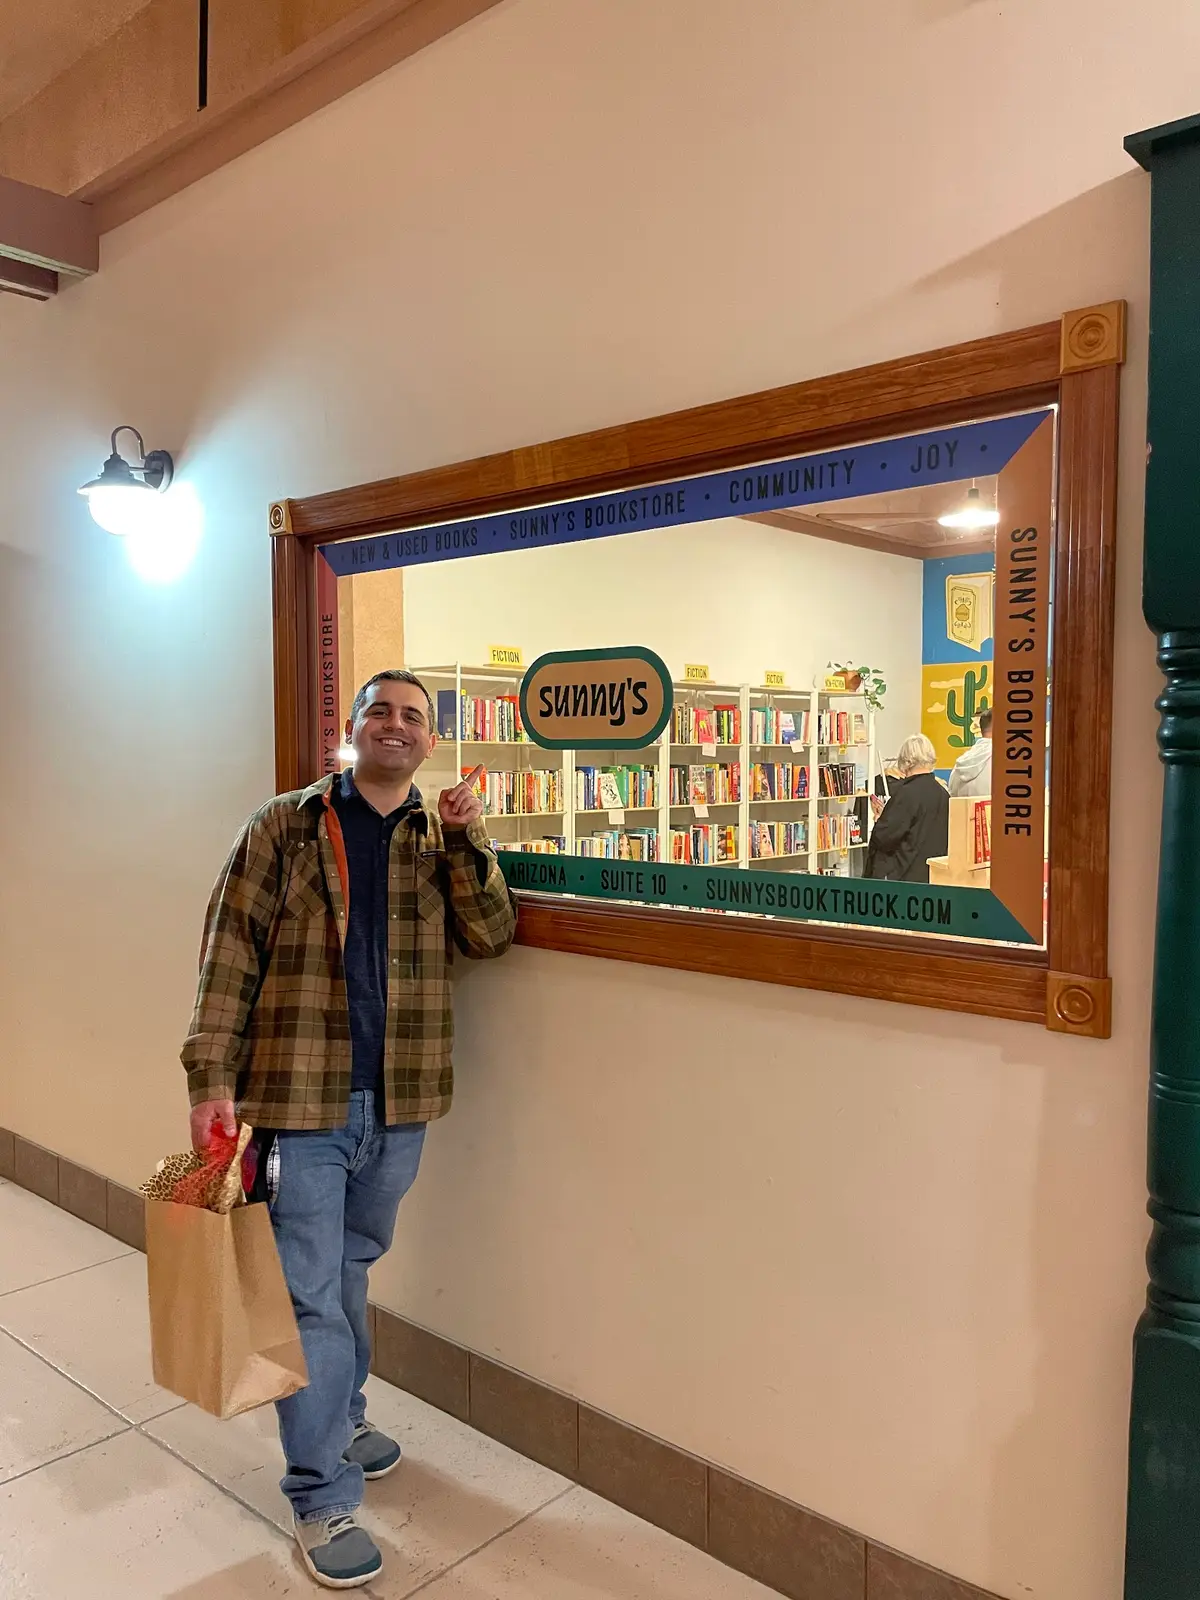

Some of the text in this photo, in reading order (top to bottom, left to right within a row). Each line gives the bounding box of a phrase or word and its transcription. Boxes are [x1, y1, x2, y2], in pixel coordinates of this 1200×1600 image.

[352, 440, 959, 565] NEW & USED BOOKS SUNNY'S BOOKSTORE COMMUNITY JOY
[322, 613, 335, 717] BOOKSTORE
[492, 649, 520, 663] FICTION
[686, 667, 707, 679] FICTION
[766, 673, 783, 685] FICTION
[1004, 527, 1038, 837] SUNNY'S BOOKSTORE
[539, 677, 648, 727] sunny's
[509, 861, 951, 925] ARIZONA SUITE 10 SUNNYSBOOKTRUCK.COM
